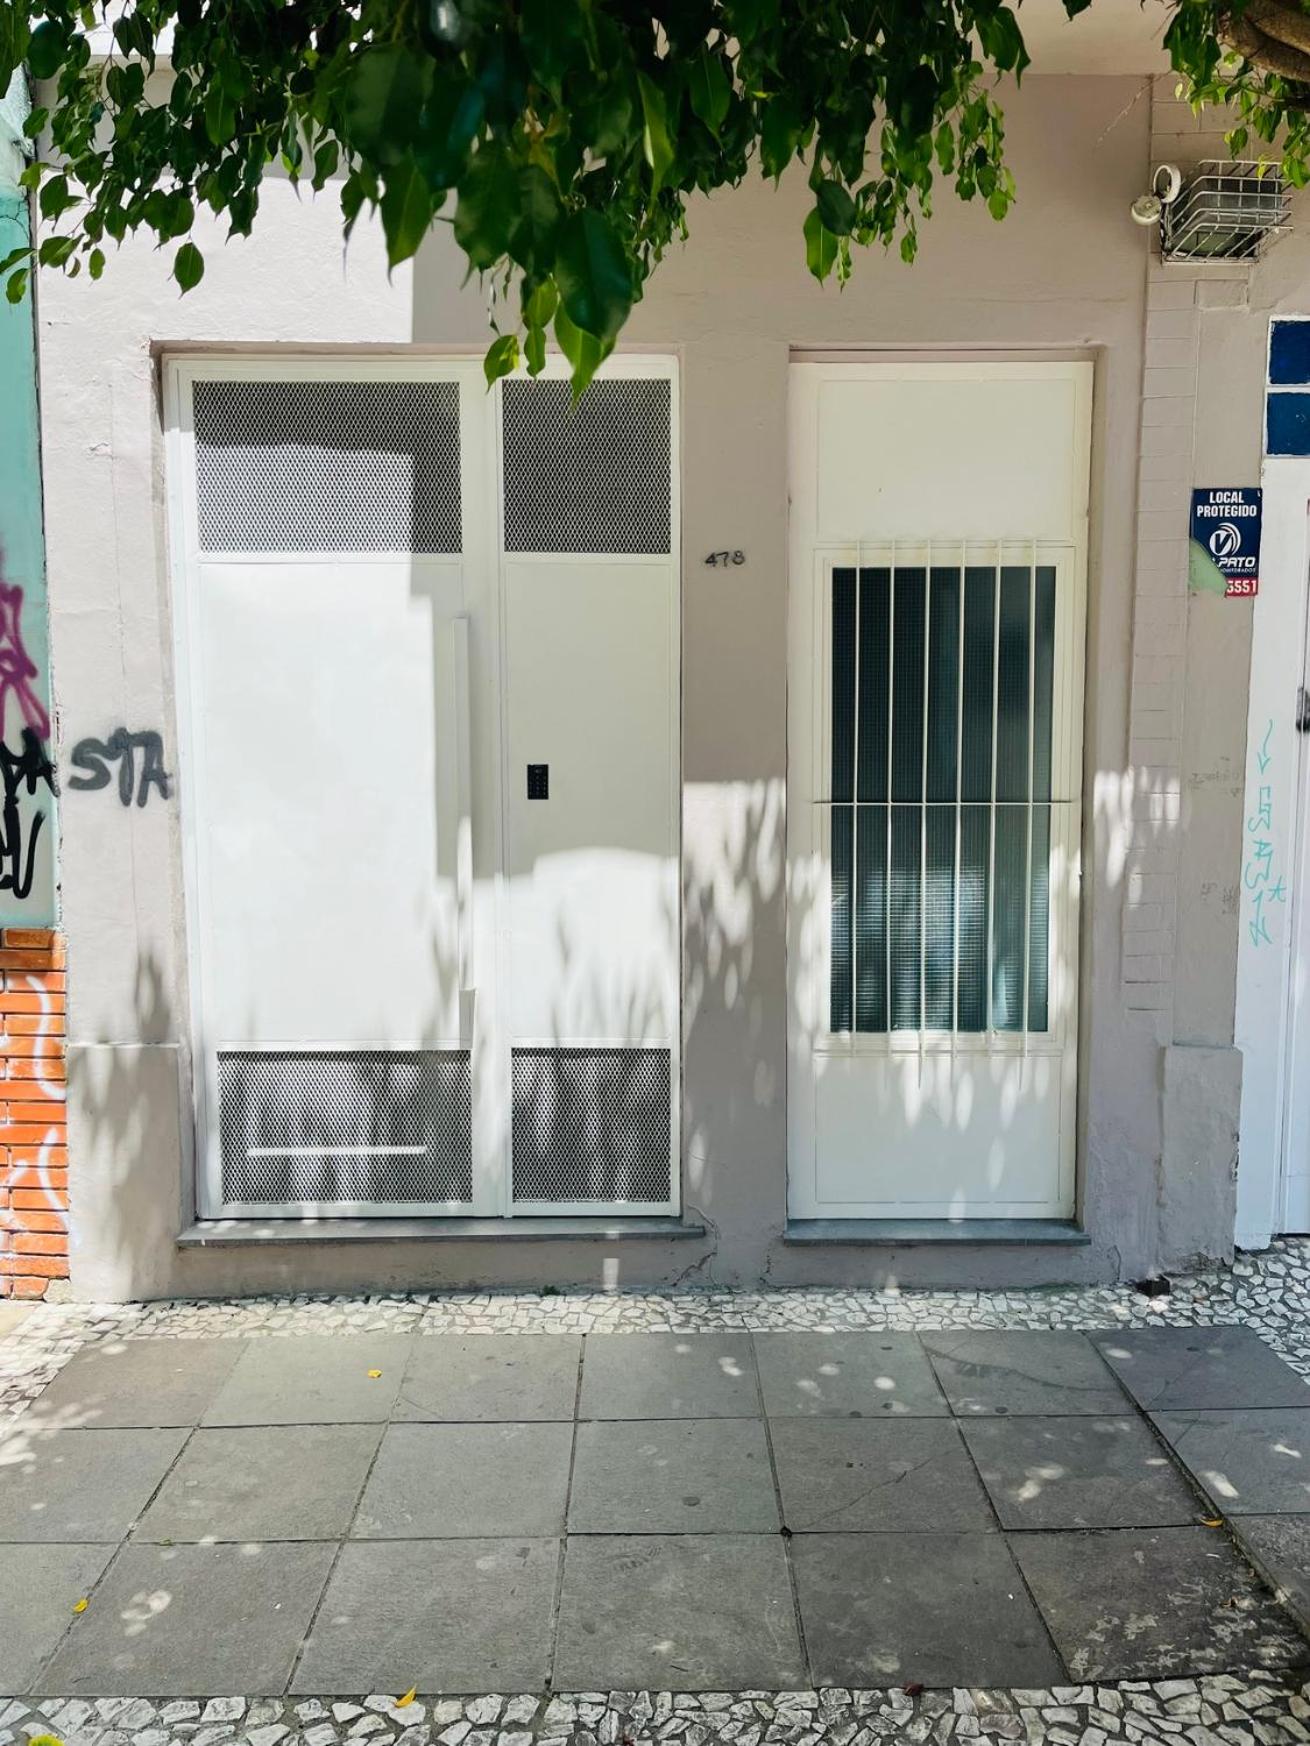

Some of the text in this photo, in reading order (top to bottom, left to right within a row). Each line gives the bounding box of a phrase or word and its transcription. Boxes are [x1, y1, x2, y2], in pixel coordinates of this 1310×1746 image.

[1209, 491, 1245, 504] LOCAL
[1196, 504, 1257, 518] PROTEGIDO
[704, 550, 746, 568] 478
